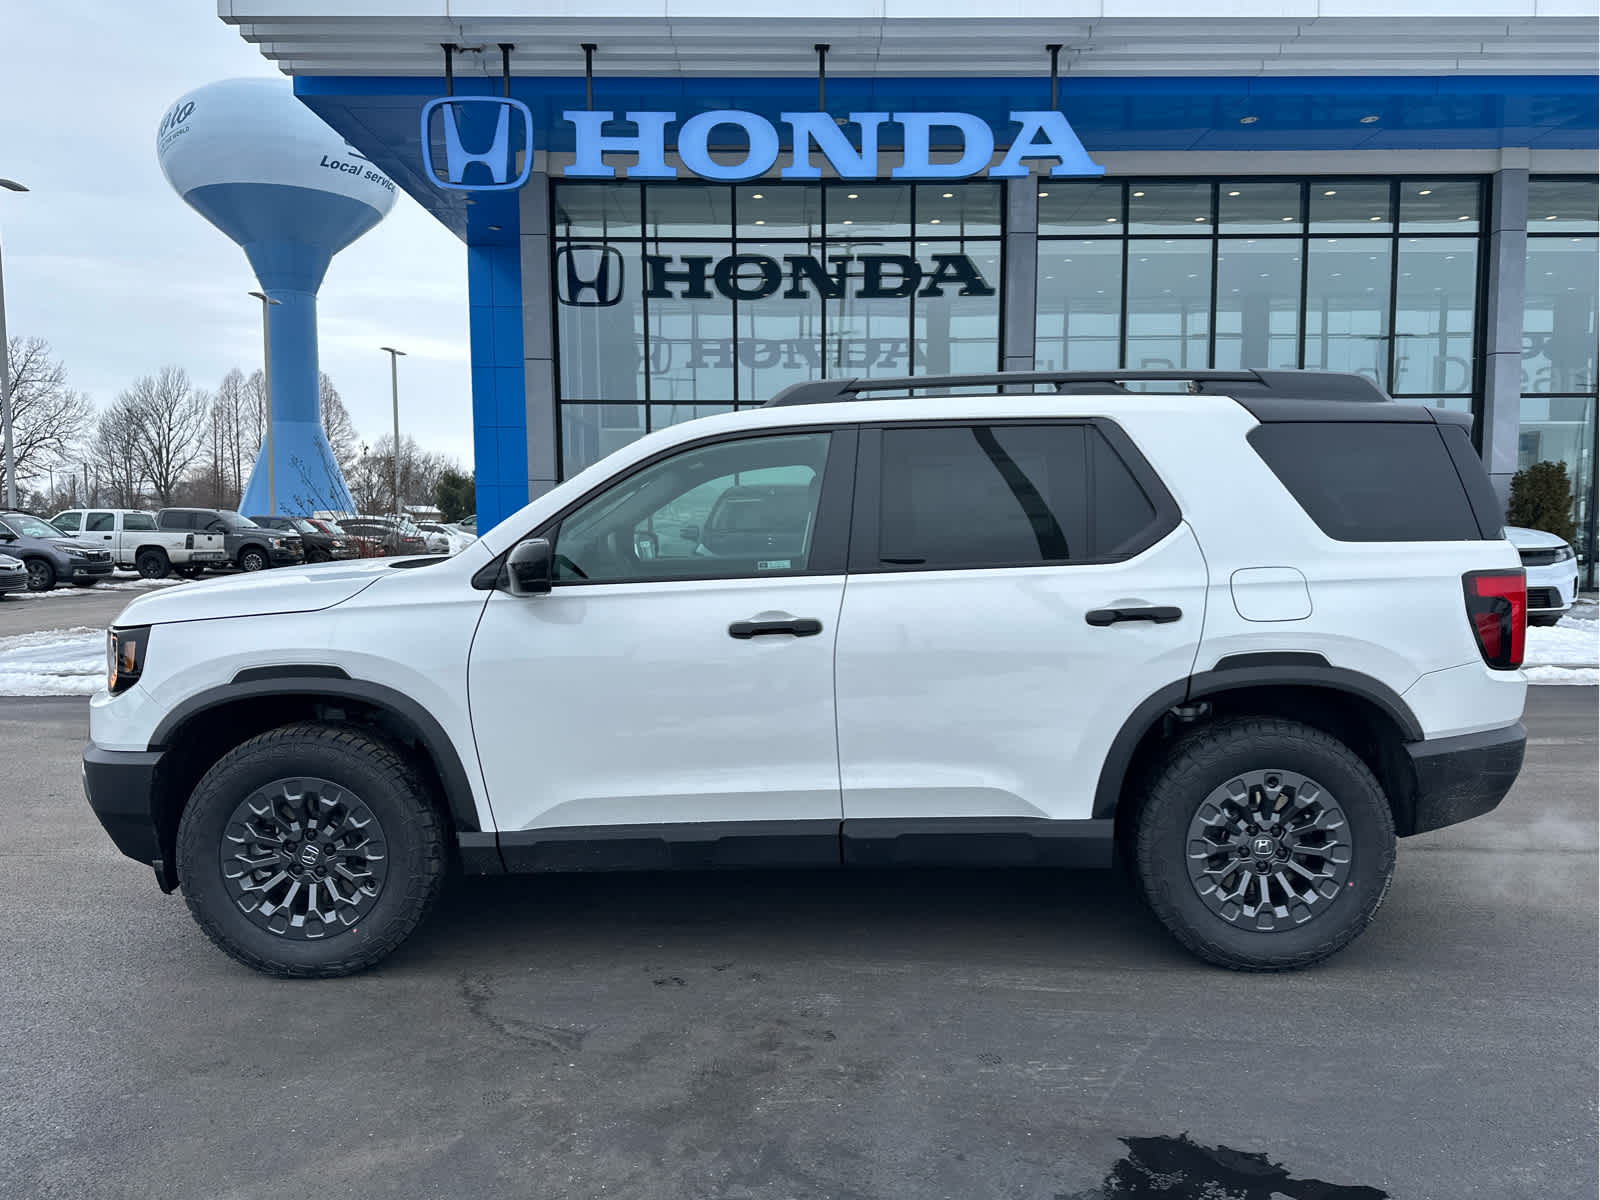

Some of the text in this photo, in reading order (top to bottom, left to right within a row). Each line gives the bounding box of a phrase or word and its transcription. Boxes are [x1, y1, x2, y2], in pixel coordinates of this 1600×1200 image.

[320, 155, 363, 176] Local
[563, 109, 1106, 180] HONDA
[646, 253, 996, 300] HONDA
